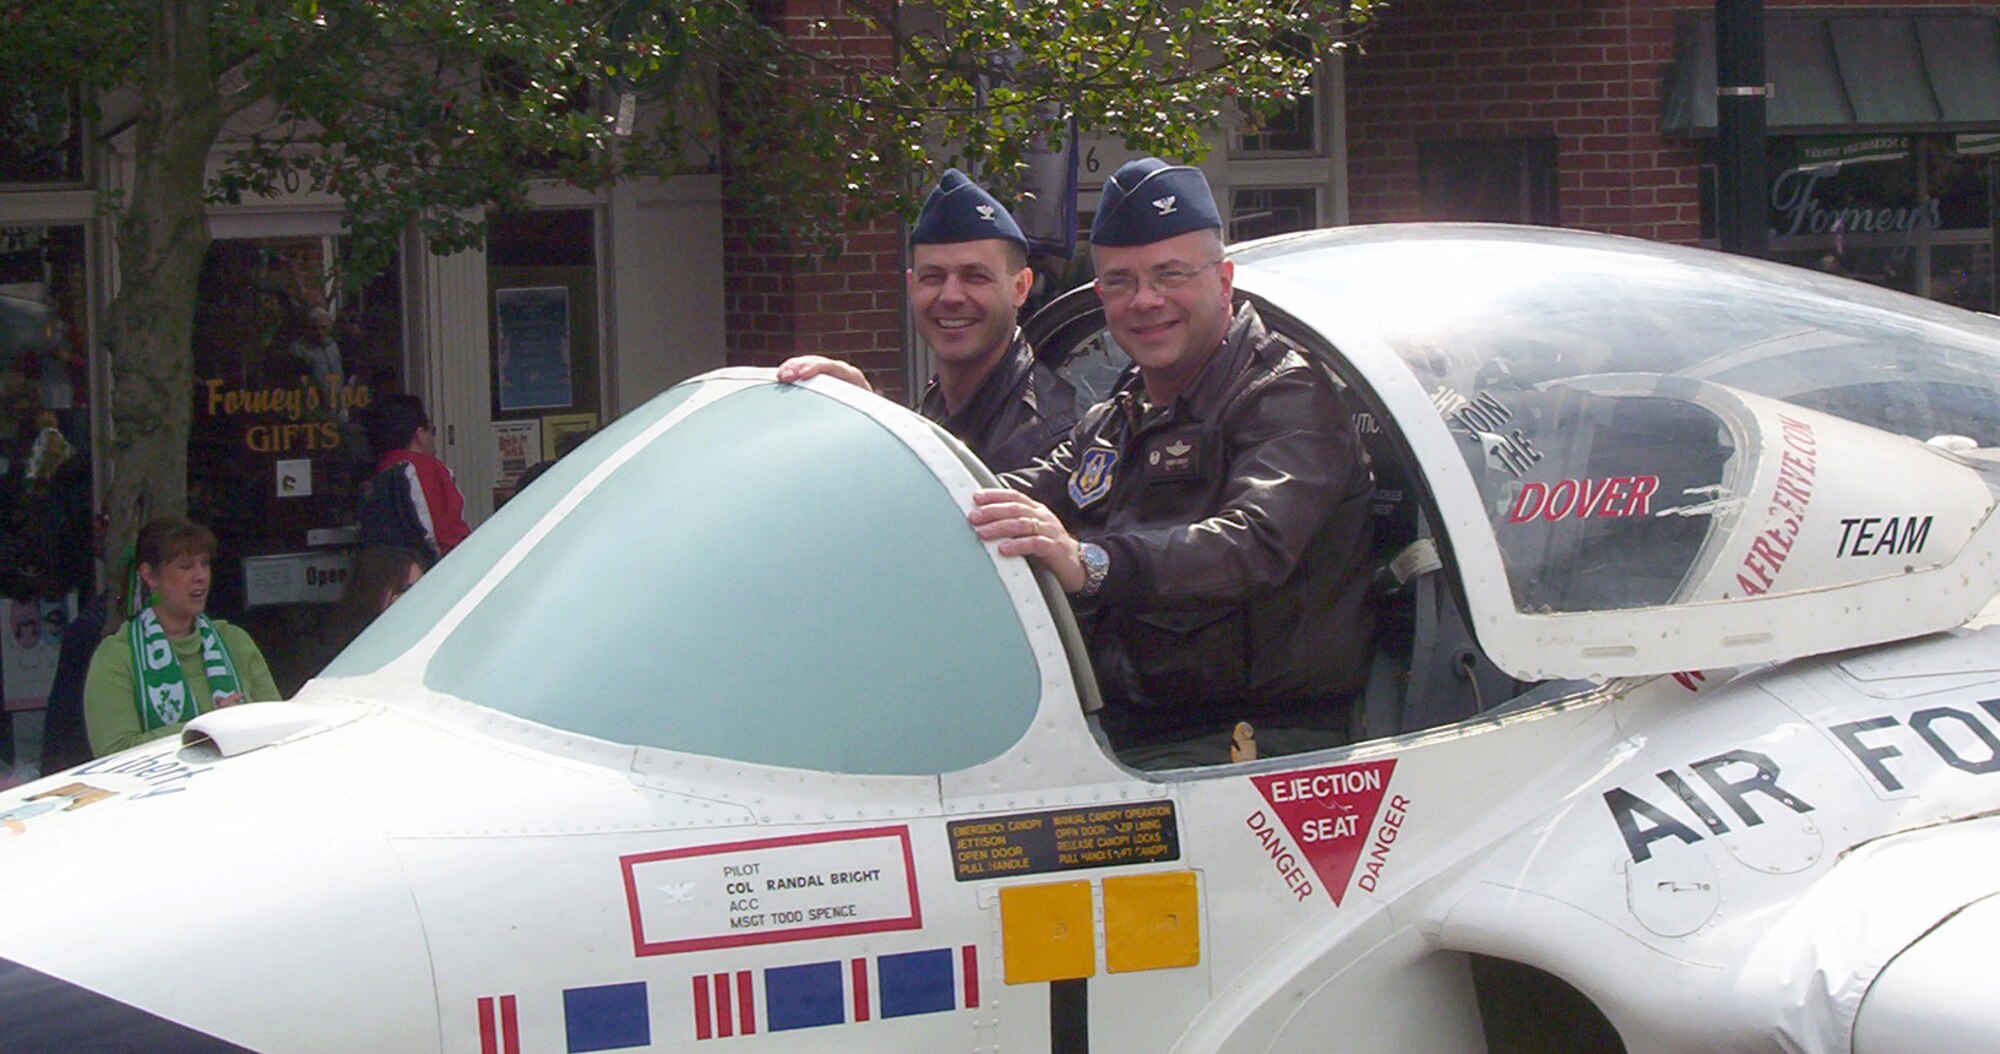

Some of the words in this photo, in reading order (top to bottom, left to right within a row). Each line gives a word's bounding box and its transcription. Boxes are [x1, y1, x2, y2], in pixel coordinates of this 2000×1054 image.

[205, 375, 320, 421] Forney's
[1452, 390, 1513, 442] JOIN
[246, 422, 341, 452] GIFTS
[1490, 428, 1544, 477] THE
[1510, 474, 1660, 524] DOVER
[1836, 515, 1933, 559] TEAM
[1271, 769, 1382, 803] EJECTION
[1602, 748, 1816, 864] AIR
[1828, 700, 2000, 793] FO
[1008, 819, 1042, 832] CANOPY
[1089, 810, 1122, 823] CANOPY
[1302, 815, 1359, 843] SEAT
[957, 836, 1007, 849] JETTISON
[958, 850, 988, 862] OPEN
[991, 846, 1024, 859] DOOR
[1097, 835, 1130, 847] CANOPY
[1358, 794, 1411, 893] DANGER
[960, 863, 984, 874] PULL
[988, 857, 1030, 871] HANDLE
[1246, 810, 1313, 902] DANGER
[723, 863, 761, 878] PILOT
[726, 882, 754, 895] COL
[766, 874, 825, 891] RANDAL
[831, 869, 881, 885] BRIGHT
[729, 898, 760, 912] ACC
[730, 914, 765, 929] MSGT
[808, 904, 858, 921] SPENCE
